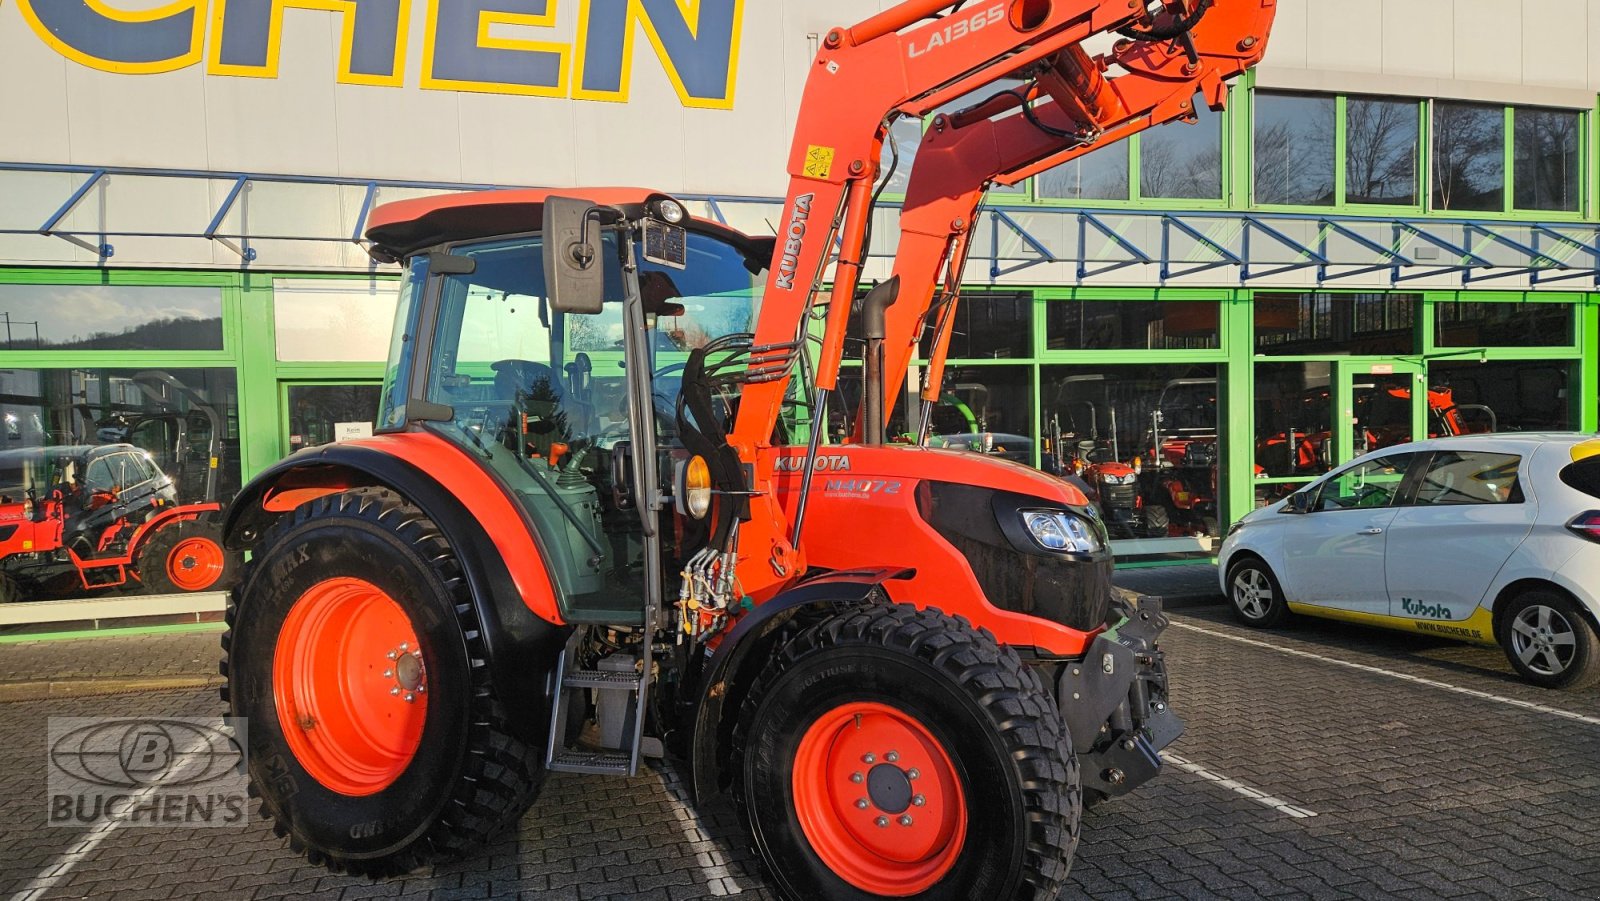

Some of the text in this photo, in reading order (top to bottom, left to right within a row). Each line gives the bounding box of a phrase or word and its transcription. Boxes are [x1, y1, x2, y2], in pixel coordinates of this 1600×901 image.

[908, 4, 1005, 58] LA1365
[776, 192, 815, 291] KUBOTA
[825, 479, 901, 493] M4072
[1402, 598, 1452, 619] Kubota
[1415, 621, 1483, 639] WWW.BUCHENS.DE
